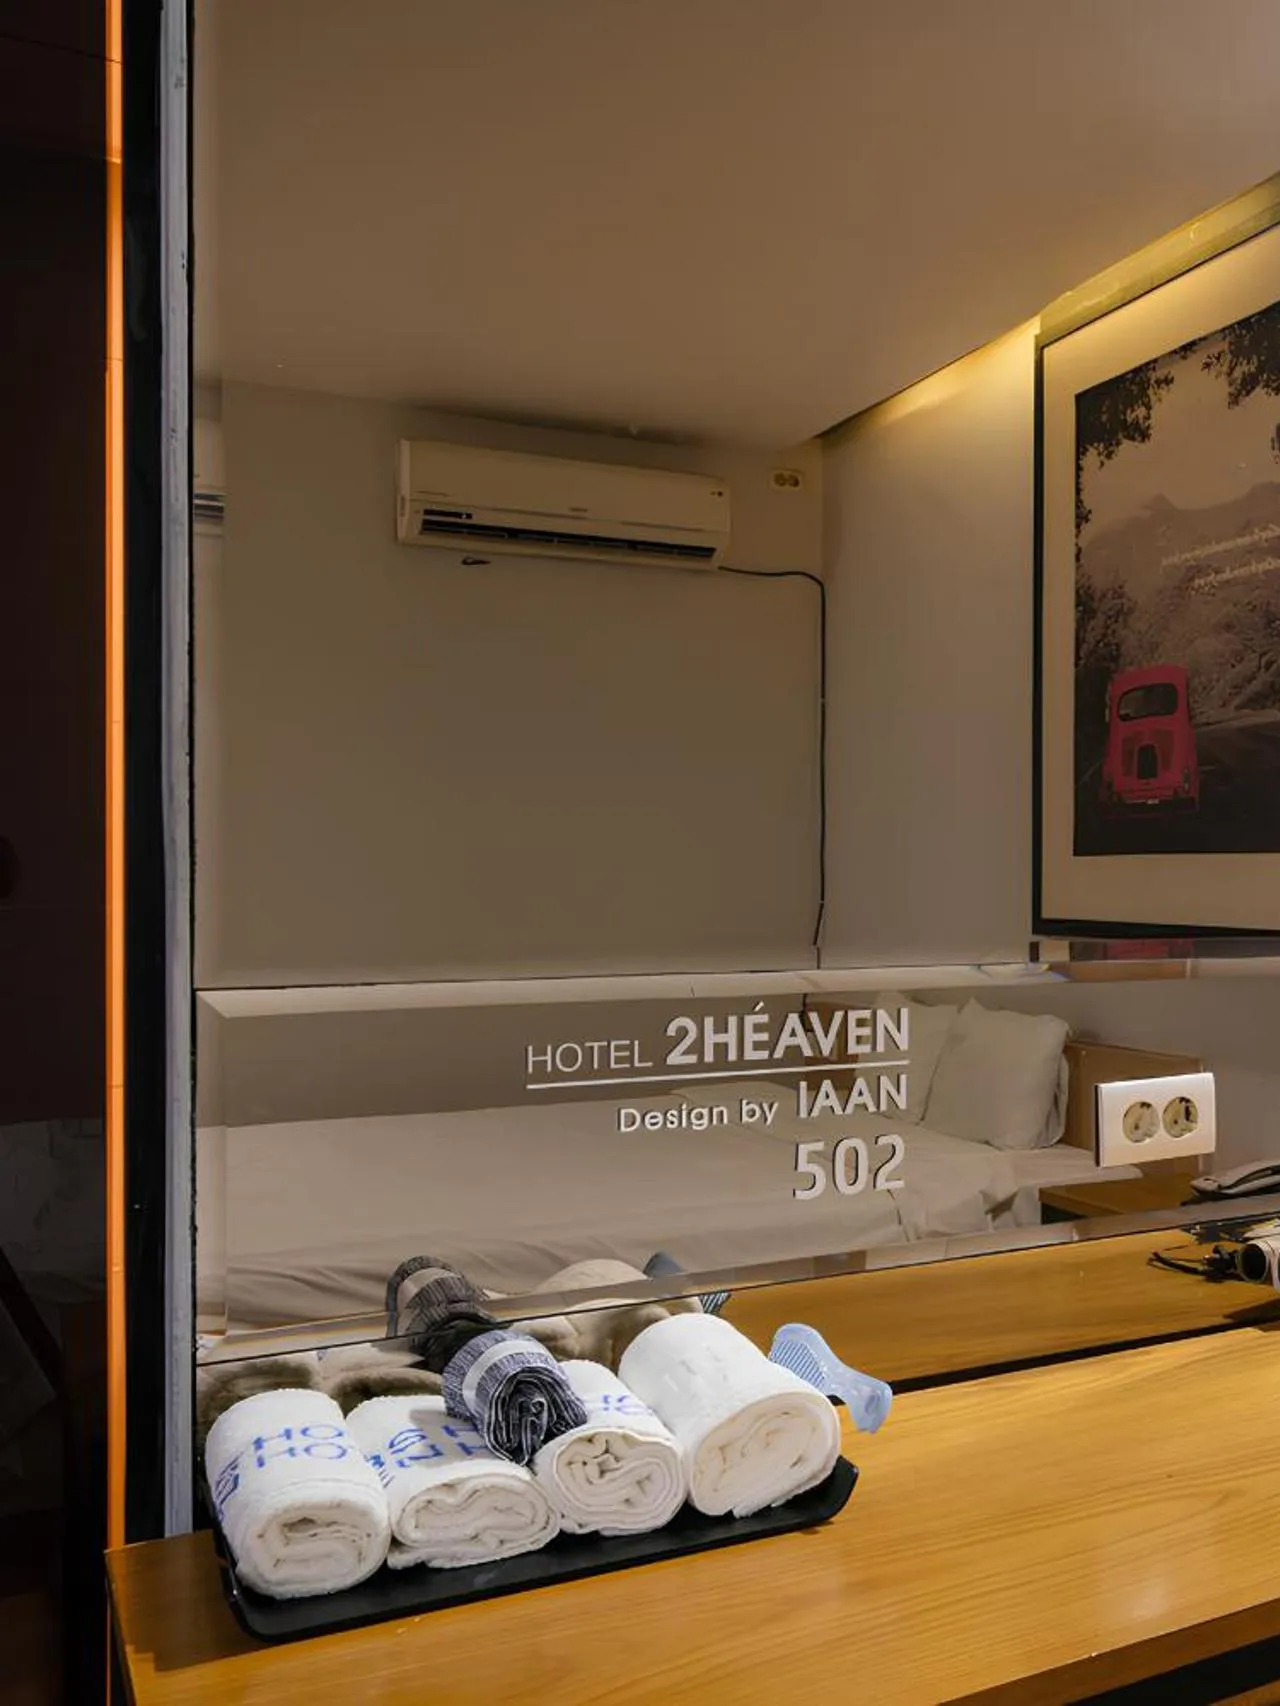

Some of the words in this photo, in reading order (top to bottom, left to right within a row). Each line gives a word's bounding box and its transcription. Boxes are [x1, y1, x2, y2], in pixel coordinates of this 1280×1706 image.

[526, 1039, 653, 1074] HOTEL
[665, 1001, 909, 1065] 2HÉAVEN
[618, 1102, 729, 1133] Design
[740, 1098, 779, 1126] by
[796, 1074, 908, 1118] IAAN
[793, 1133, 906, 1200] 502
